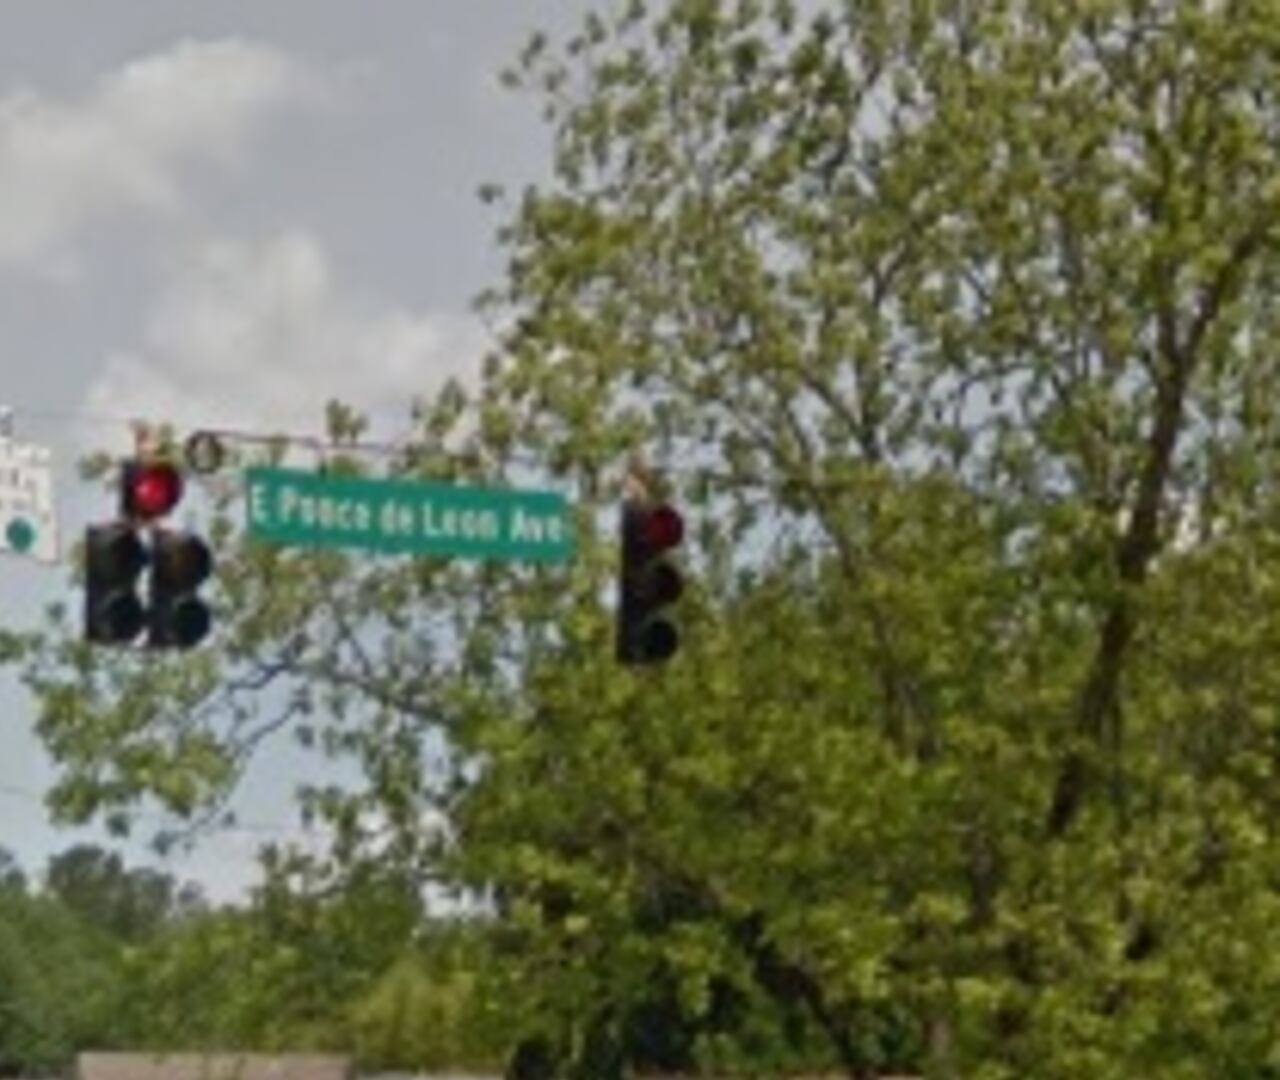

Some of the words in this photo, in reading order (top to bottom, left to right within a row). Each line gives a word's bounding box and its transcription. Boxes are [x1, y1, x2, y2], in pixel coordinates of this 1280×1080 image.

[250, 484, 268, 524] E
[278, 485, 371, 532] Ponce
[380, 498, 415, 537] de
[423, 501, 499, 541] Leon
[509, 506, 563, 543] Ave
